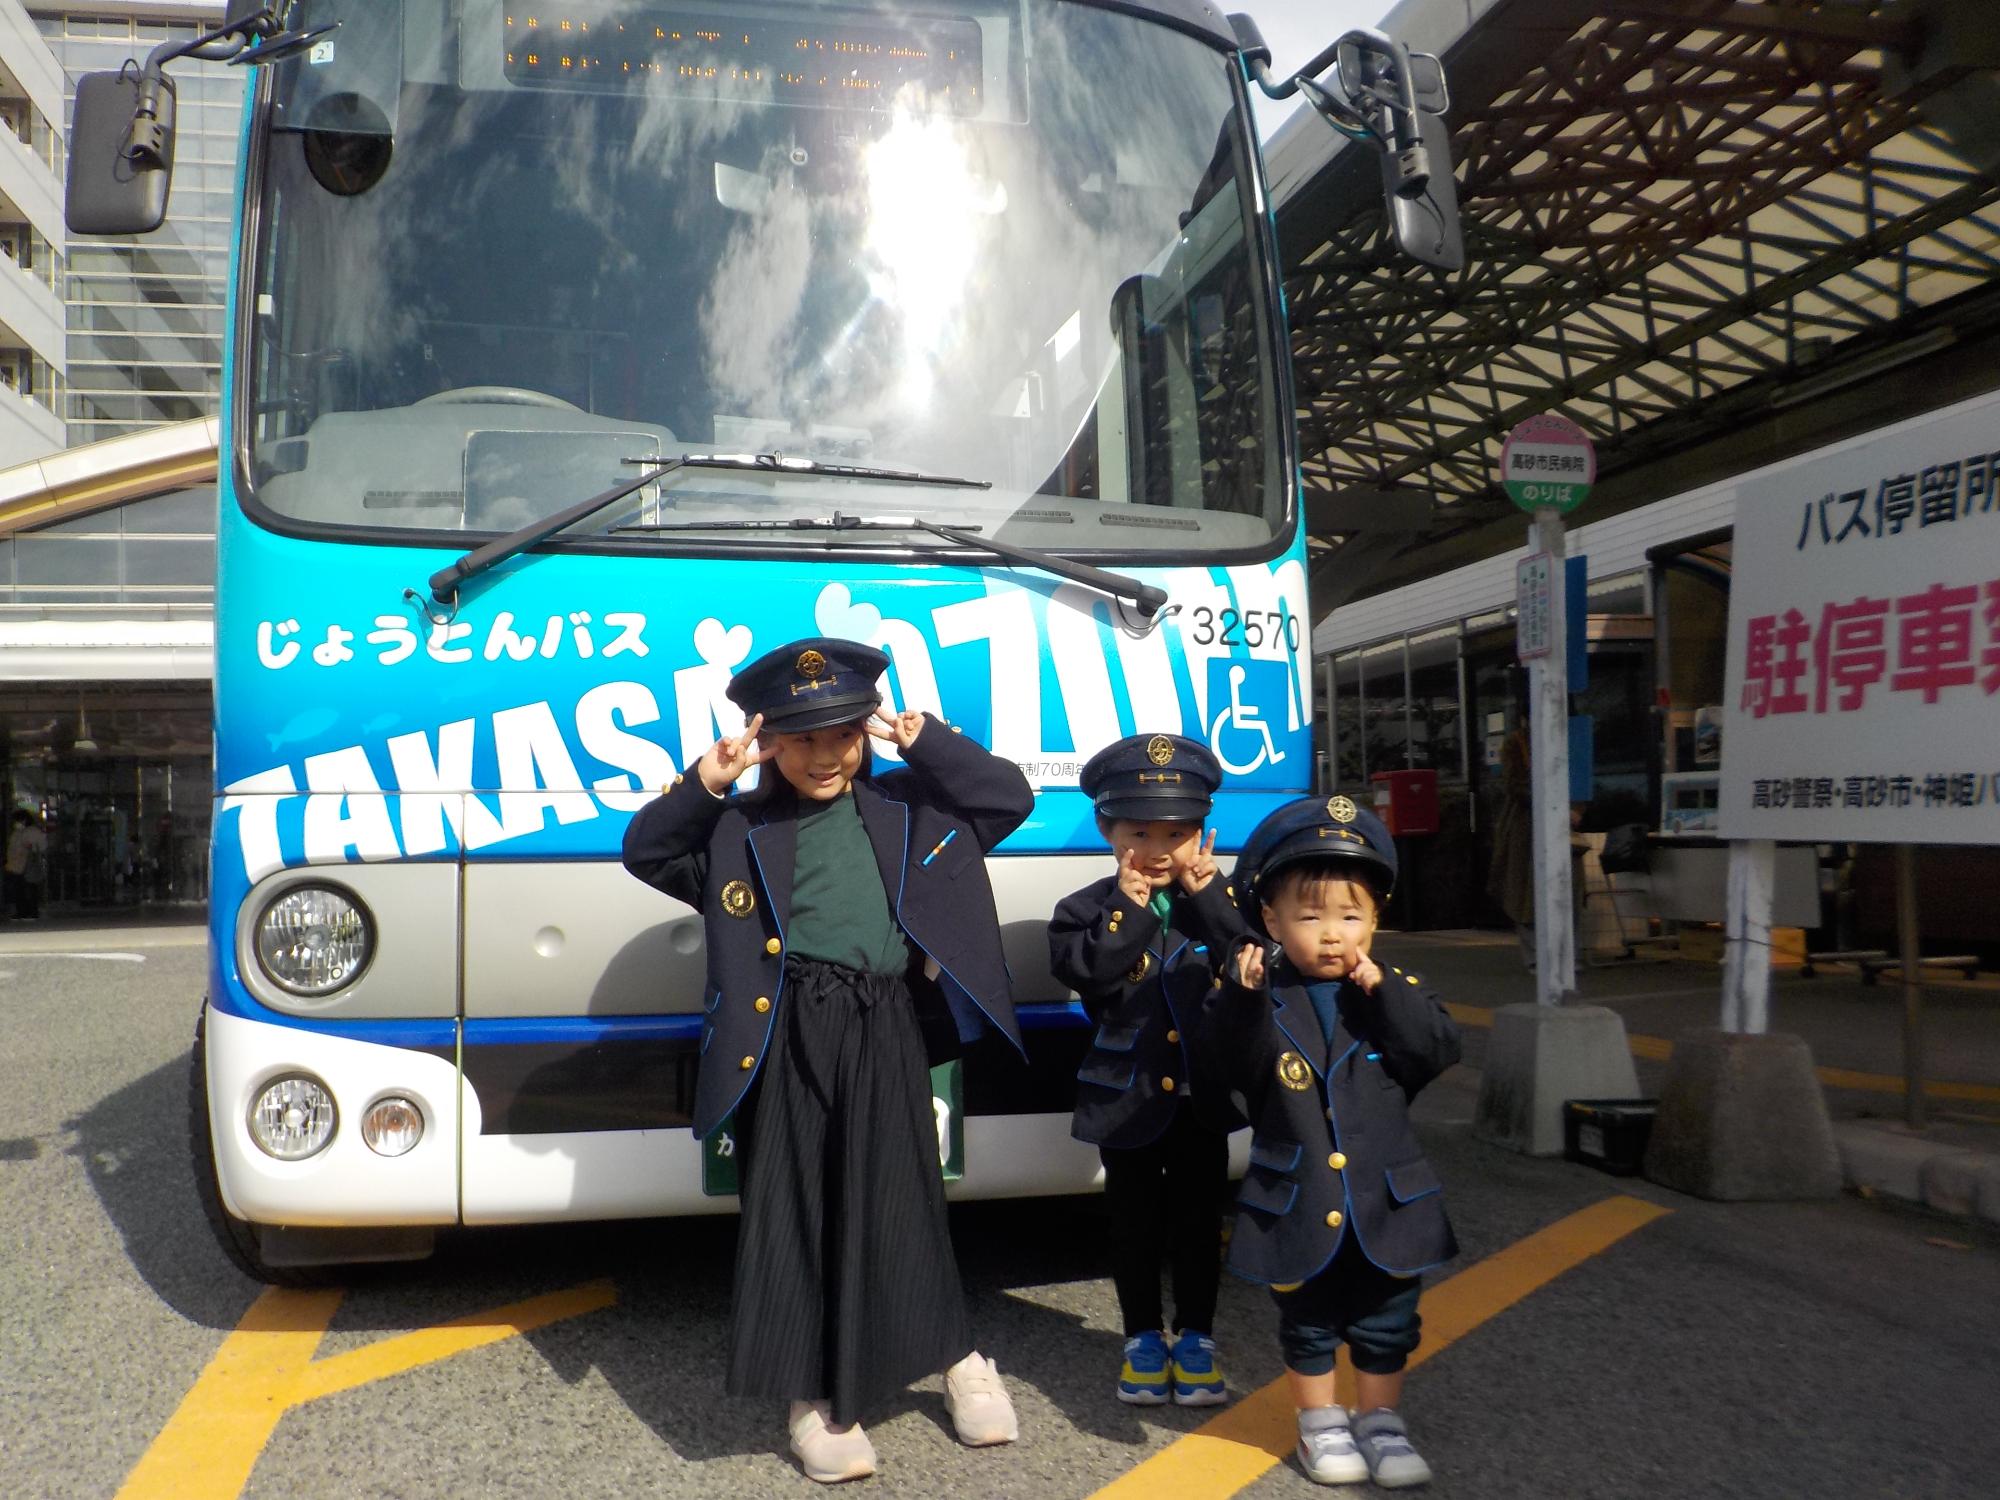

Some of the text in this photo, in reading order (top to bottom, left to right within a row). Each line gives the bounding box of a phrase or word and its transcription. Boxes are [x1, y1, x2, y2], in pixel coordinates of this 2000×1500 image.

[1511, 453, 1585, 473] 高砂市民病院
[1522, 485, 1572, 503] のりば
[256, 611, 650, 669] じょうとんバス
[1193, 605, 1300, 653] 32570
[1740, 578, 2000, 720] 駐停車
